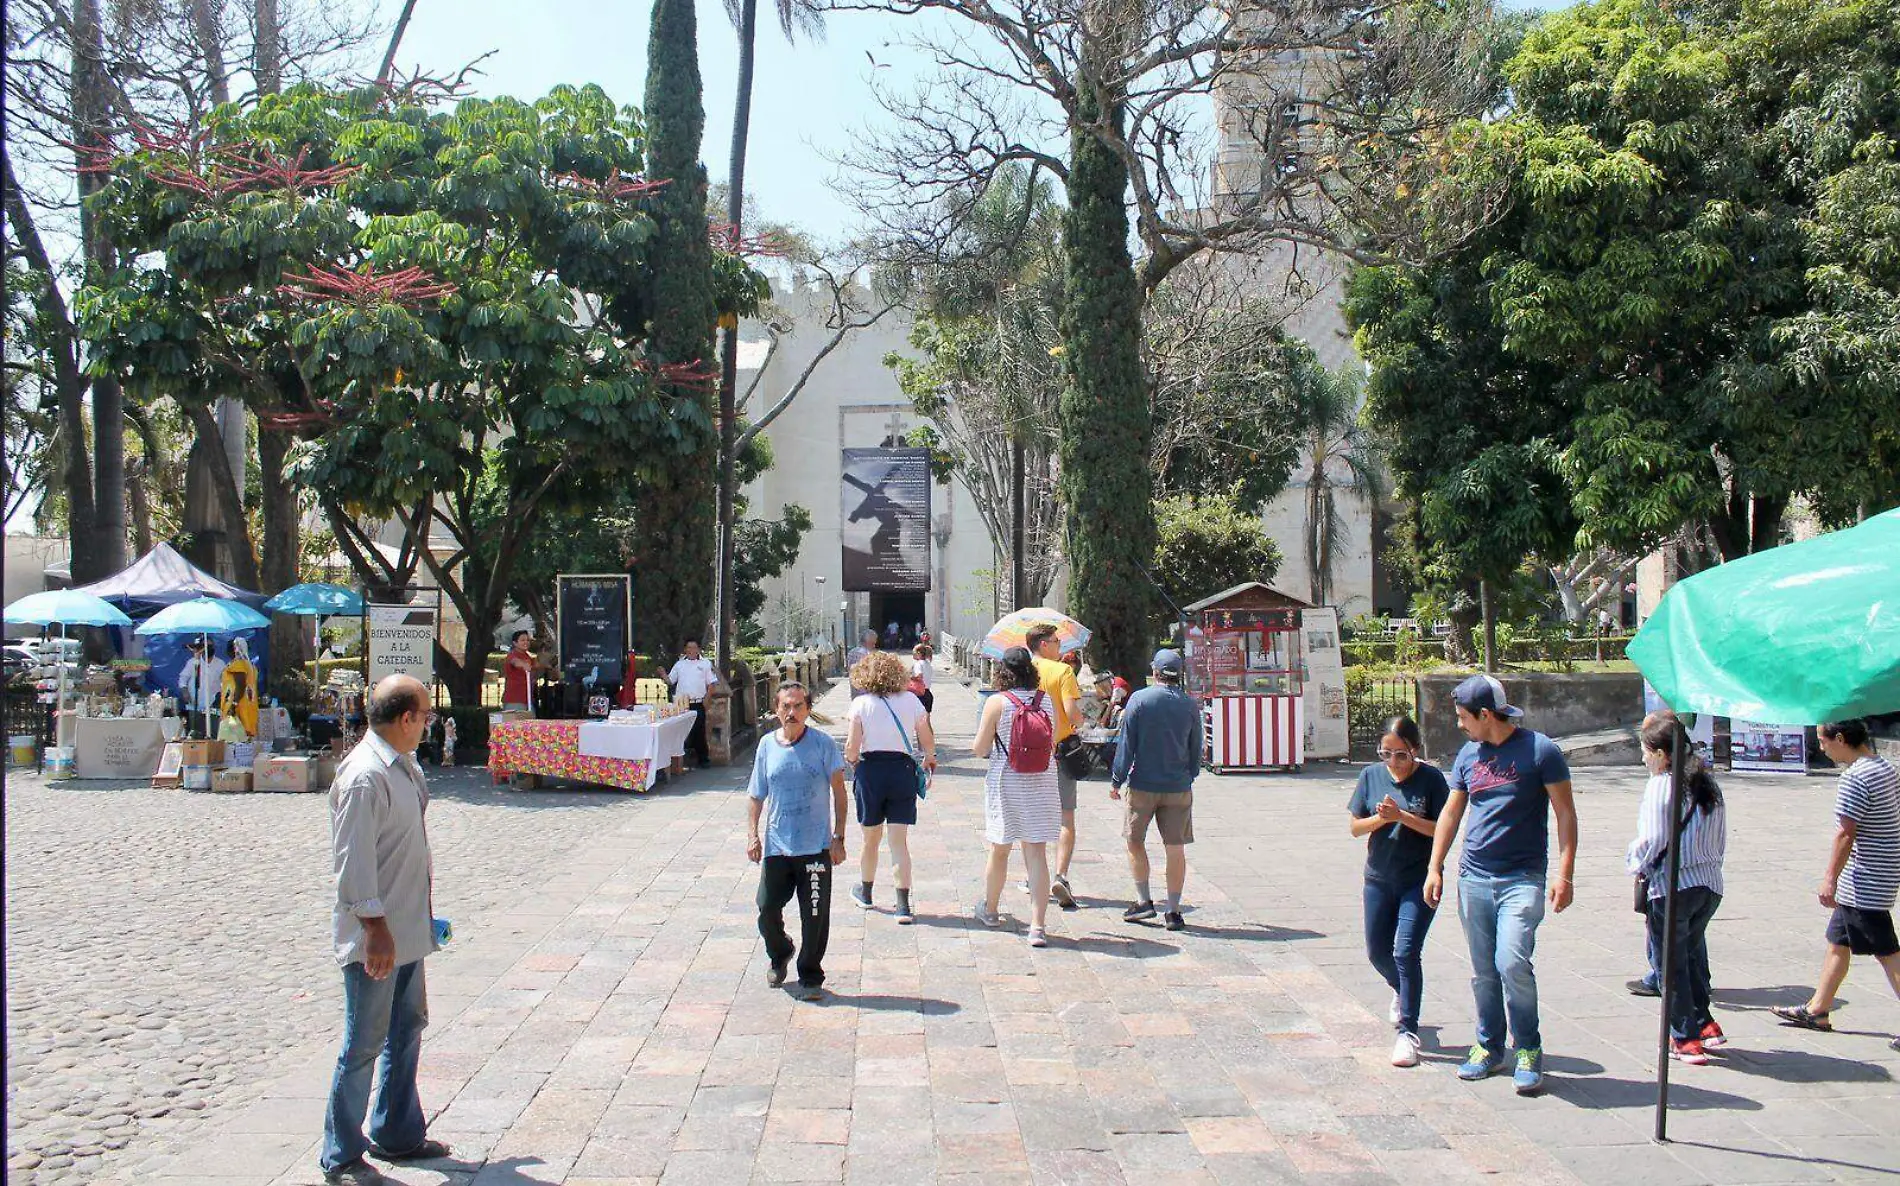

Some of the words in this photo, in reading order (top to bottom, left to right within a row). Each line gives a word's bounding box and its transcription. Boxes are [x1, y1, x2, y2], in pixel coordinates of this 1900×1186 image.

[371, 628, 431, 639] BIENVENIDOS
[390, 642, 397, 652] A
[399, 642, 411, 652] LA
[377, 655, 424, 665] CATEDRAL
